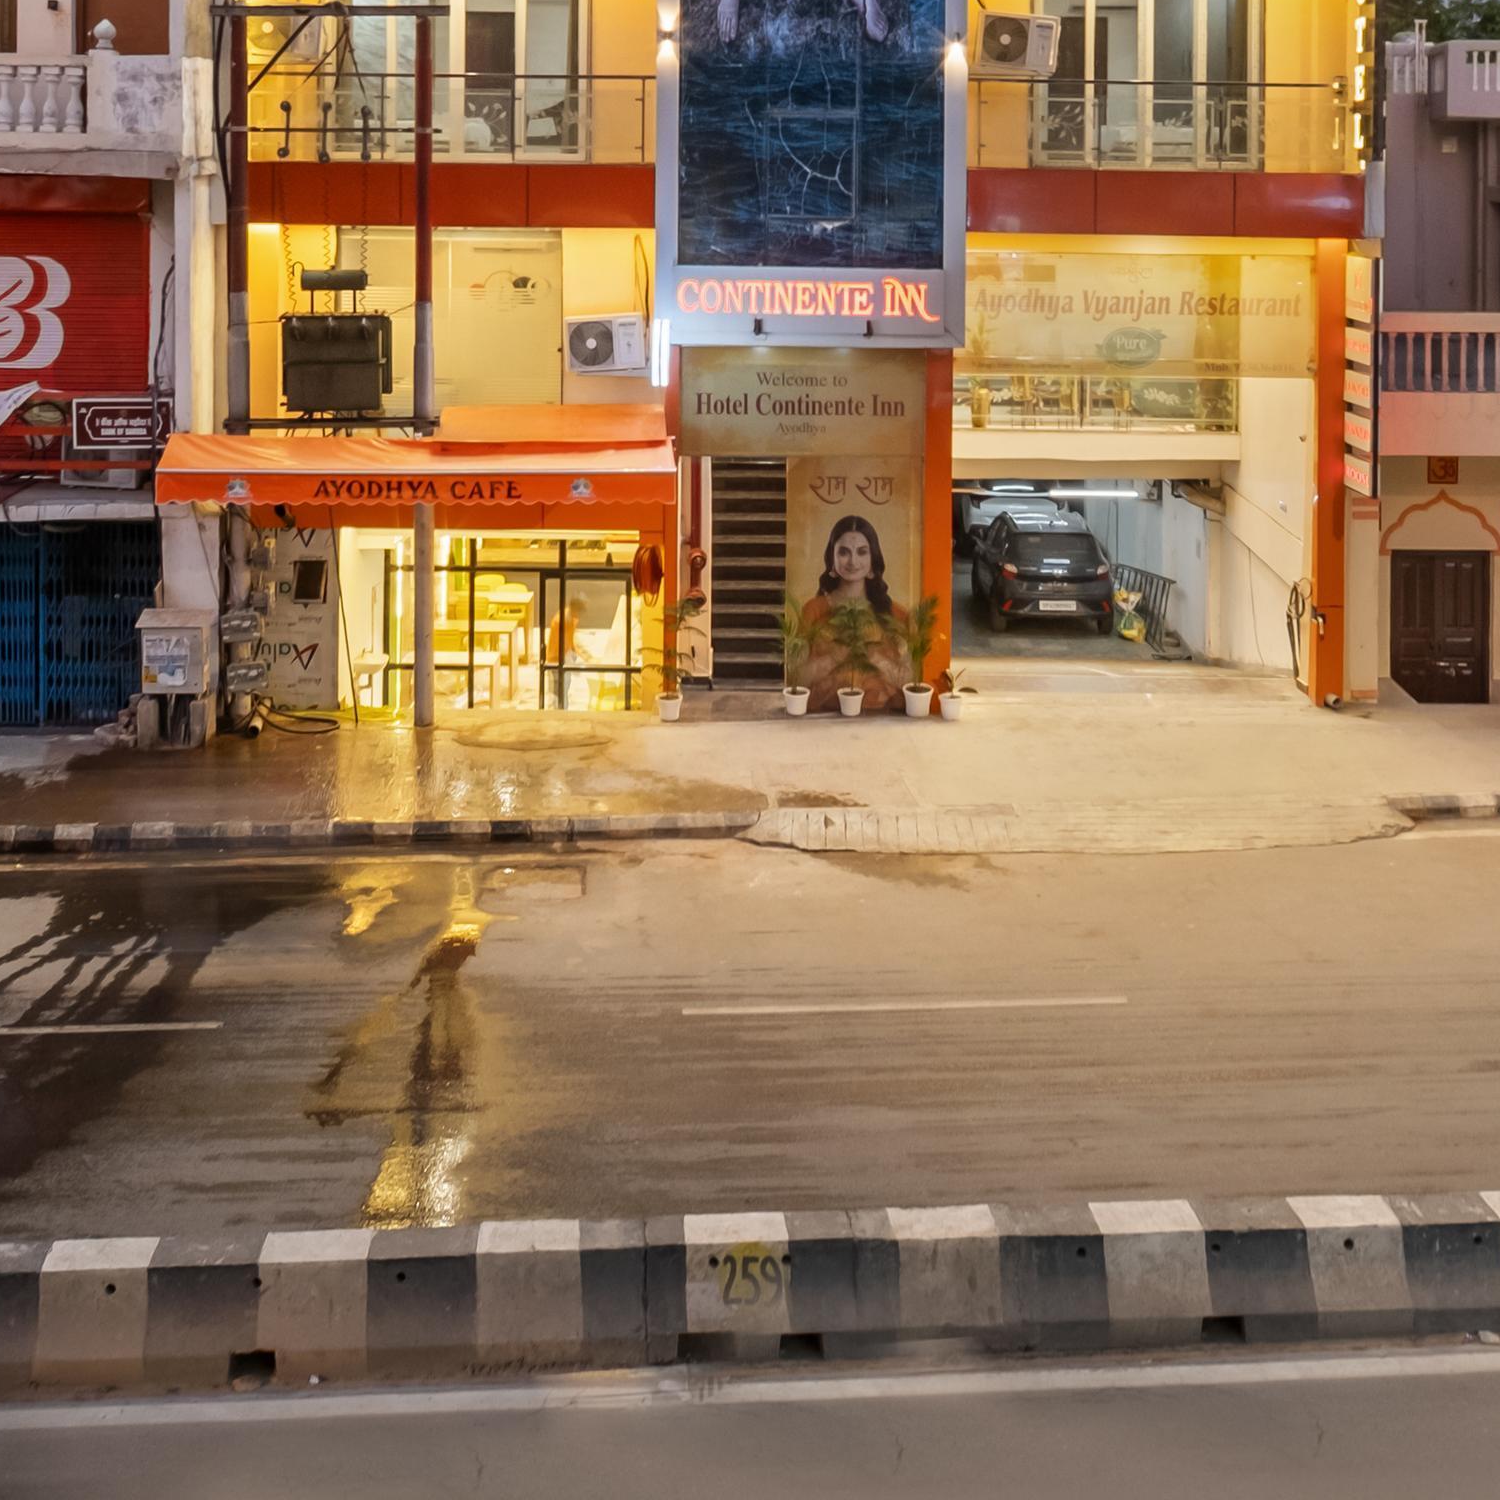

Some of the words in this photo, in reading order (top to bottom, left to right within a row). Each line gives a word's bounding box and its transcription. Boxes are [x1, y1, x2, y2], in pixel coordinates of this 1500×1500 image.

[677, 278, 875, 316] CONTINENTE
[881, 276, 940, 323] INN
[974, 288, 1073, 321] Ayodhya
[1081, 289, 1170, 322] Vyanjan
[1178, 291, 1301, 318] Restaurant
[1112, 335, 1148, 350] Pure
[756, 372, 827, 389] Welcome
[833, 373, 848, 388] to
[695, 392, 749, 416] Hotel
[756, 392, 865, 417] Continente
[871, 394, 906, 417] Inn
[776, 422, 827, 437] Ayodhya
[314, 479, 439, 500] AYODHYA
[450, 480, 522, 500] CAFE
[808, 475, 848, 505] राम
[855, 476, 895, 506] राम
[723, 1254, 783, 1306] 259
